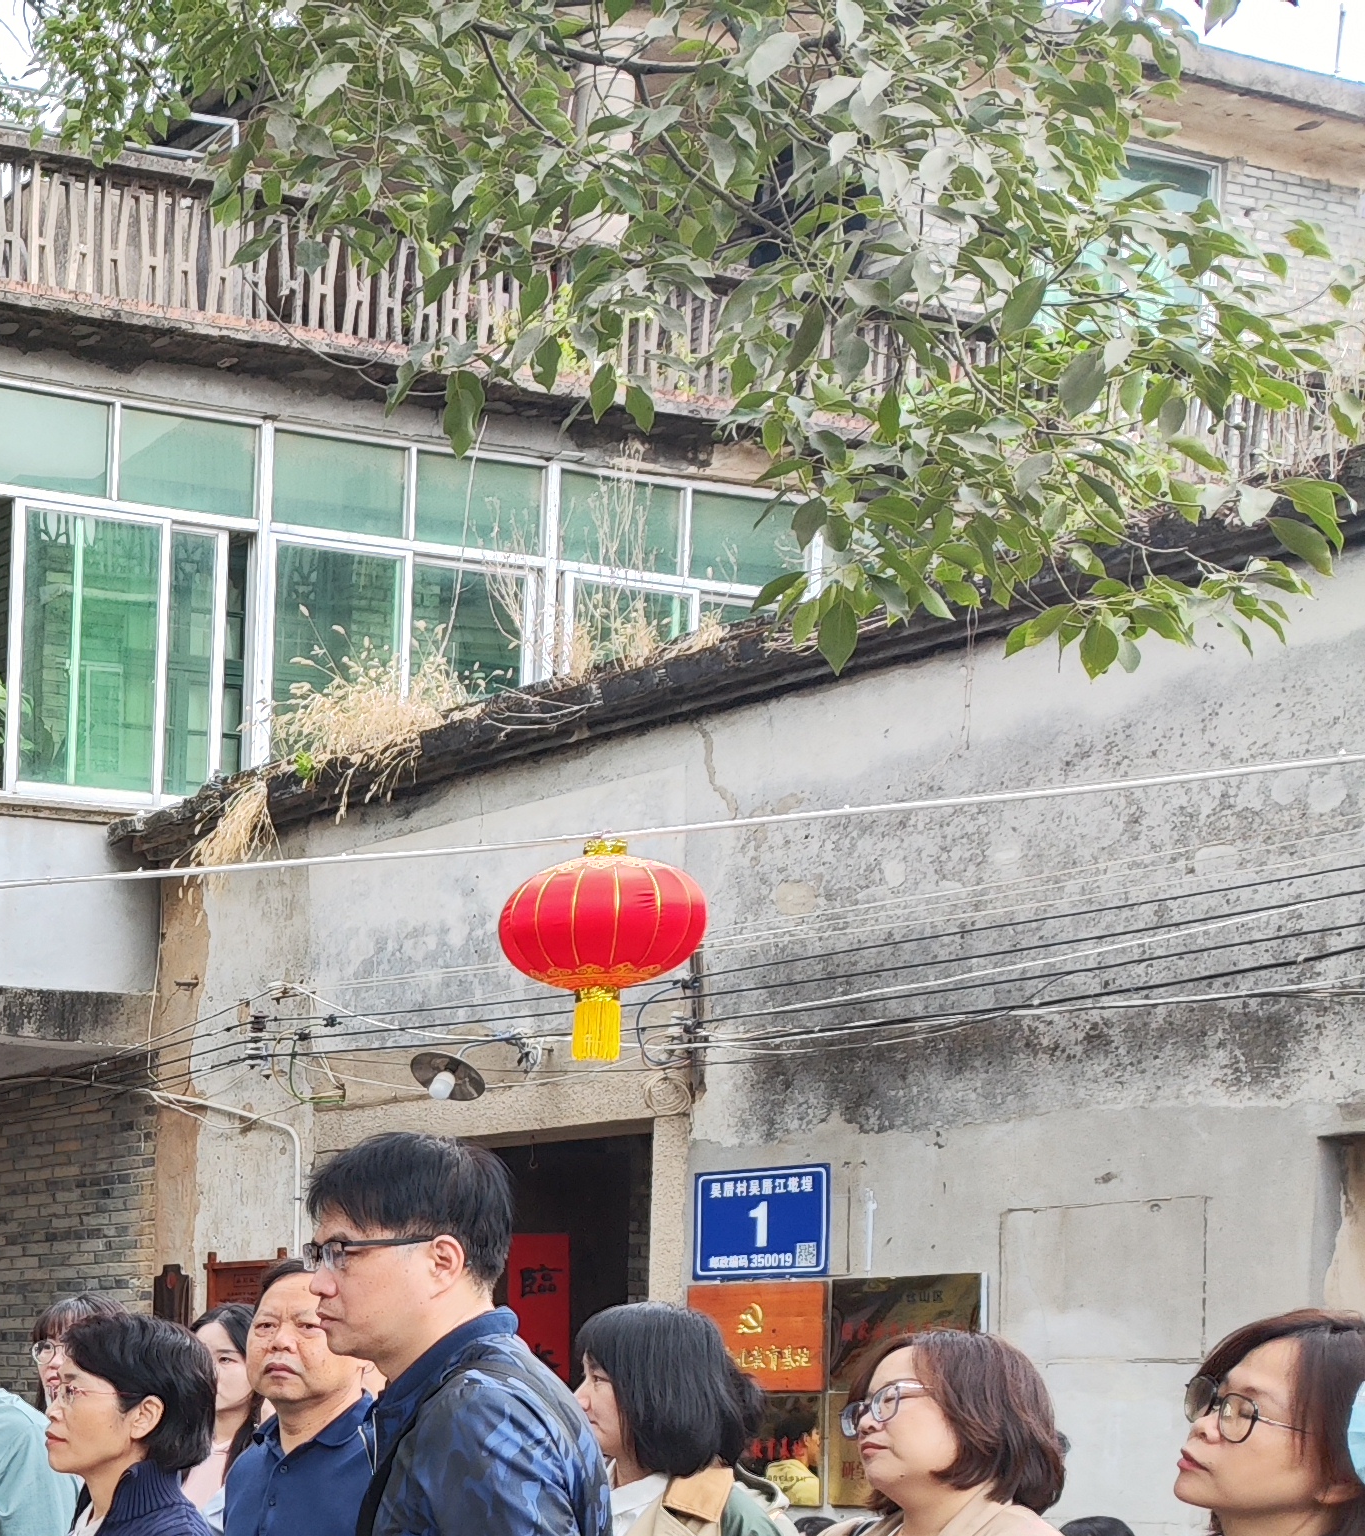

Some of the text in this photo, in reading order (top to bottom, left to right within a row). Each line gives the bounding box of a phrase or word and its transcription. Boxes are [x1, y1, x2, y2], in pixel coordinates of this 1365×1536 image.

[749, 1201, 767, 1247] 1
[708, 1253, 793, 1269] 邮政编码 350019
